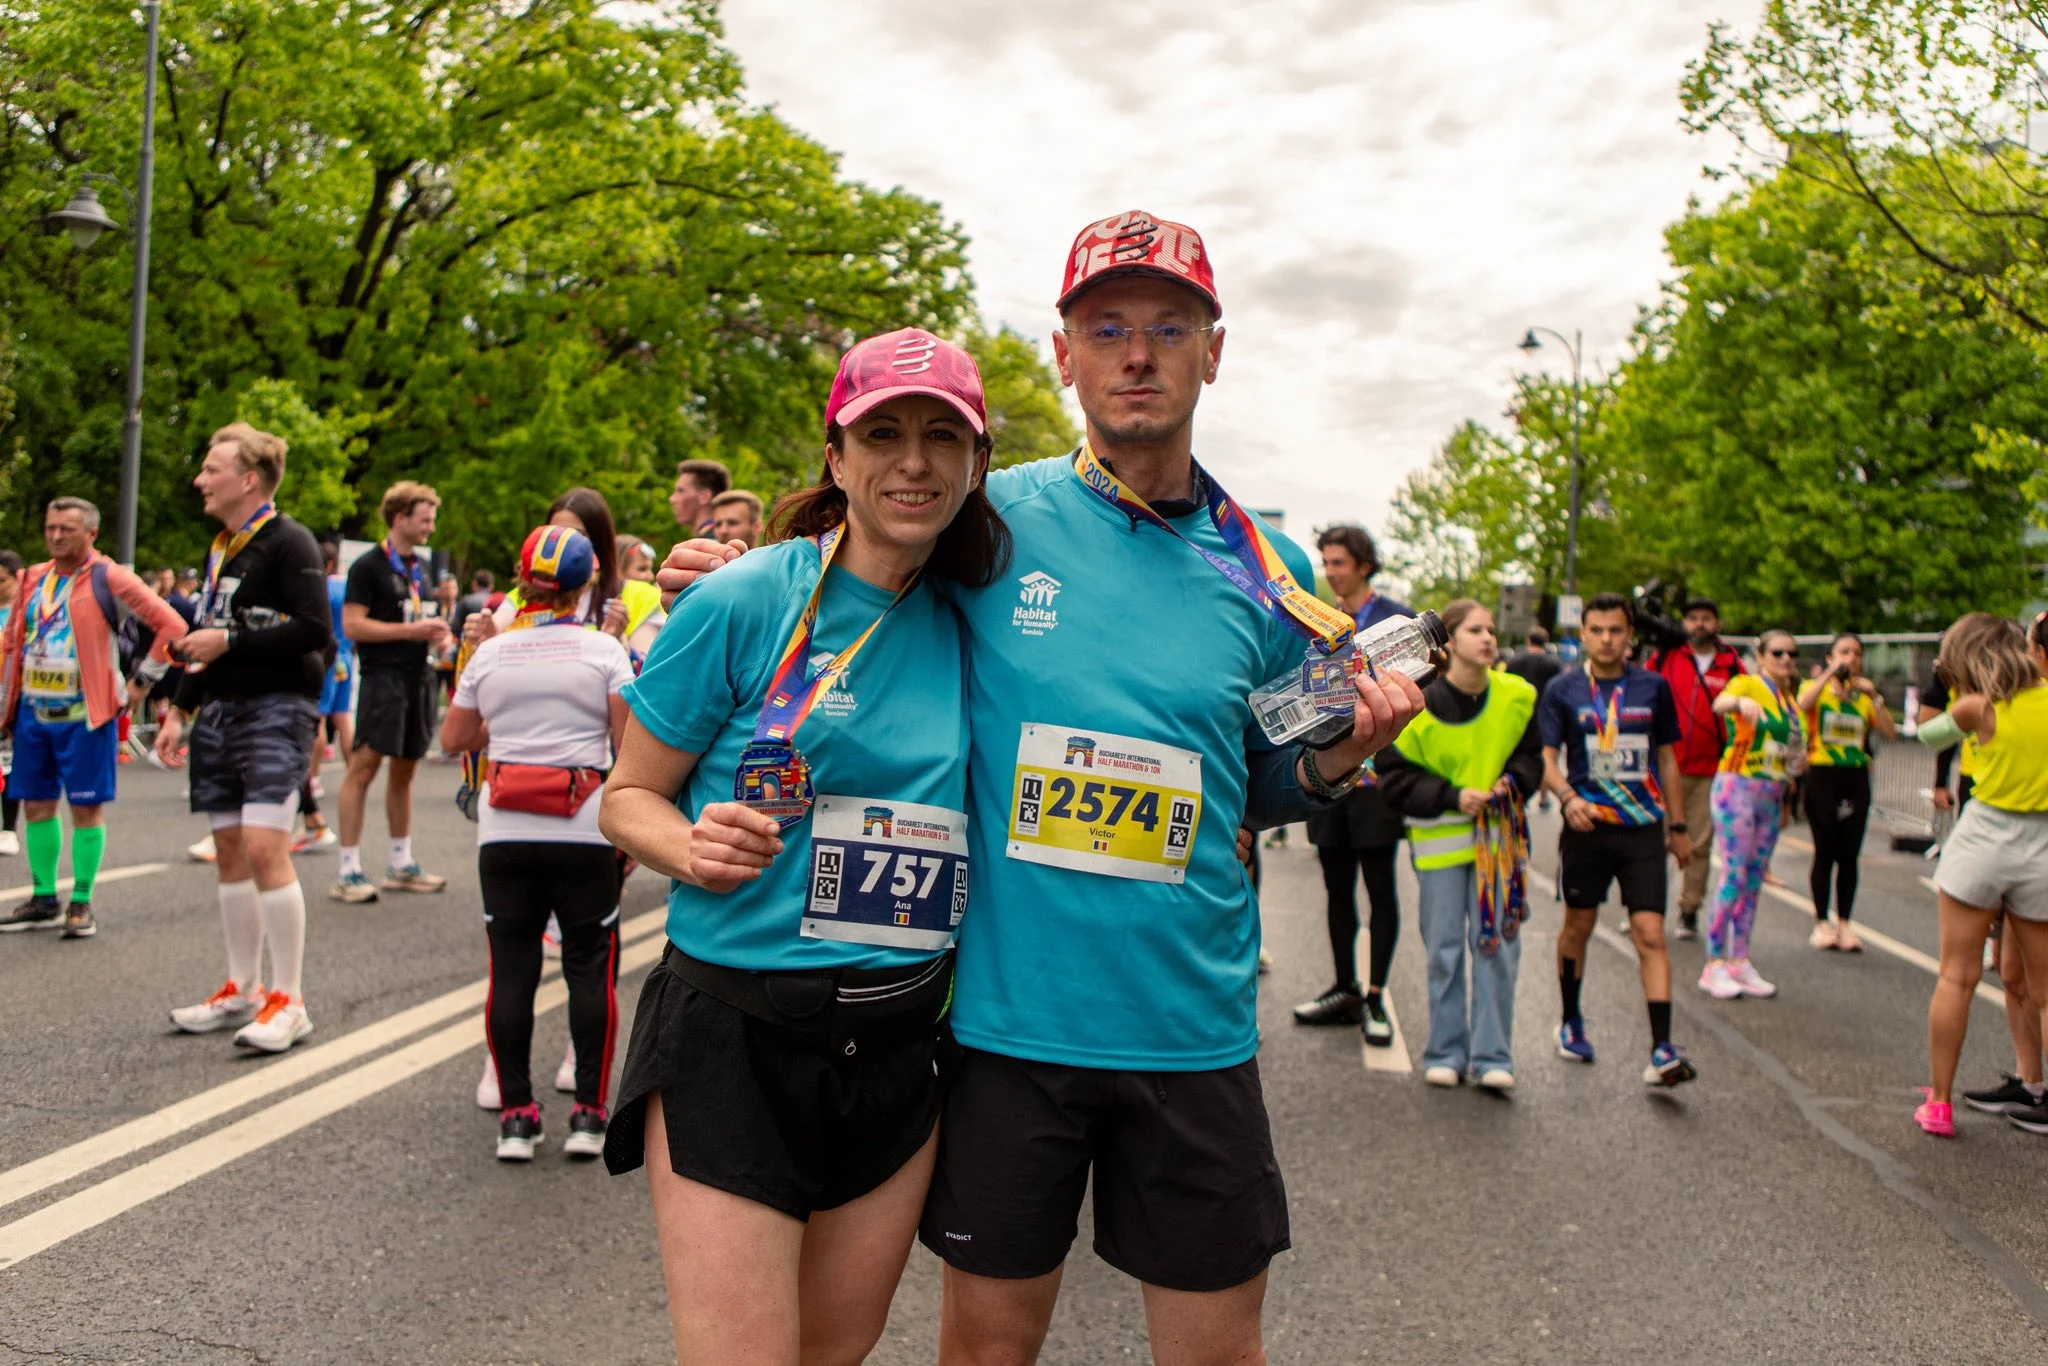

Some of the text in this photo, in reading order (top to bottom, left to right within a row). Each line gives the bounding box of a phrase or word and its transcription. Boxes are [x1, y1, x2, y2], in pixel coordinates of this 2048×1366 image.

[1084, 462, 1119, 502] 2024
[1013, 606, 1057, 621] Habitat
[1012, 618, 1056, 630] for Humanity
[821, 691, 855, 704] abitat
[1314, 690, 1337, 699] BUCHAREST
[1315, 697, 1327, 705] HALF
[1327, 694, 1354, 704] MARATHON
[824, 702, 856, 711] Humanity
[1098, 749, 1162, 766] BUCHAREST INTERNATIONAL
[1097, 757, 1113, 766] HALF
[1112, 759, 1144, 772] MARATHON
[1144, 764, 1149, 773] &
[1150, 765, 1161, 775] 10K
[1045, 777, 1160, 833] 2574
[897, 818, 950, 833] BUCHAREST INTERNATIONAL
[896, 826, 911, 836] HALF
[910, 828, 938, 840] MARATHON
[1089, 826, 1117, 839] Victor
[859, 849, 944, 899] 757
[894, 900, 912, 910] Ana
[945, 1231, 972, 1241] EVADICT
